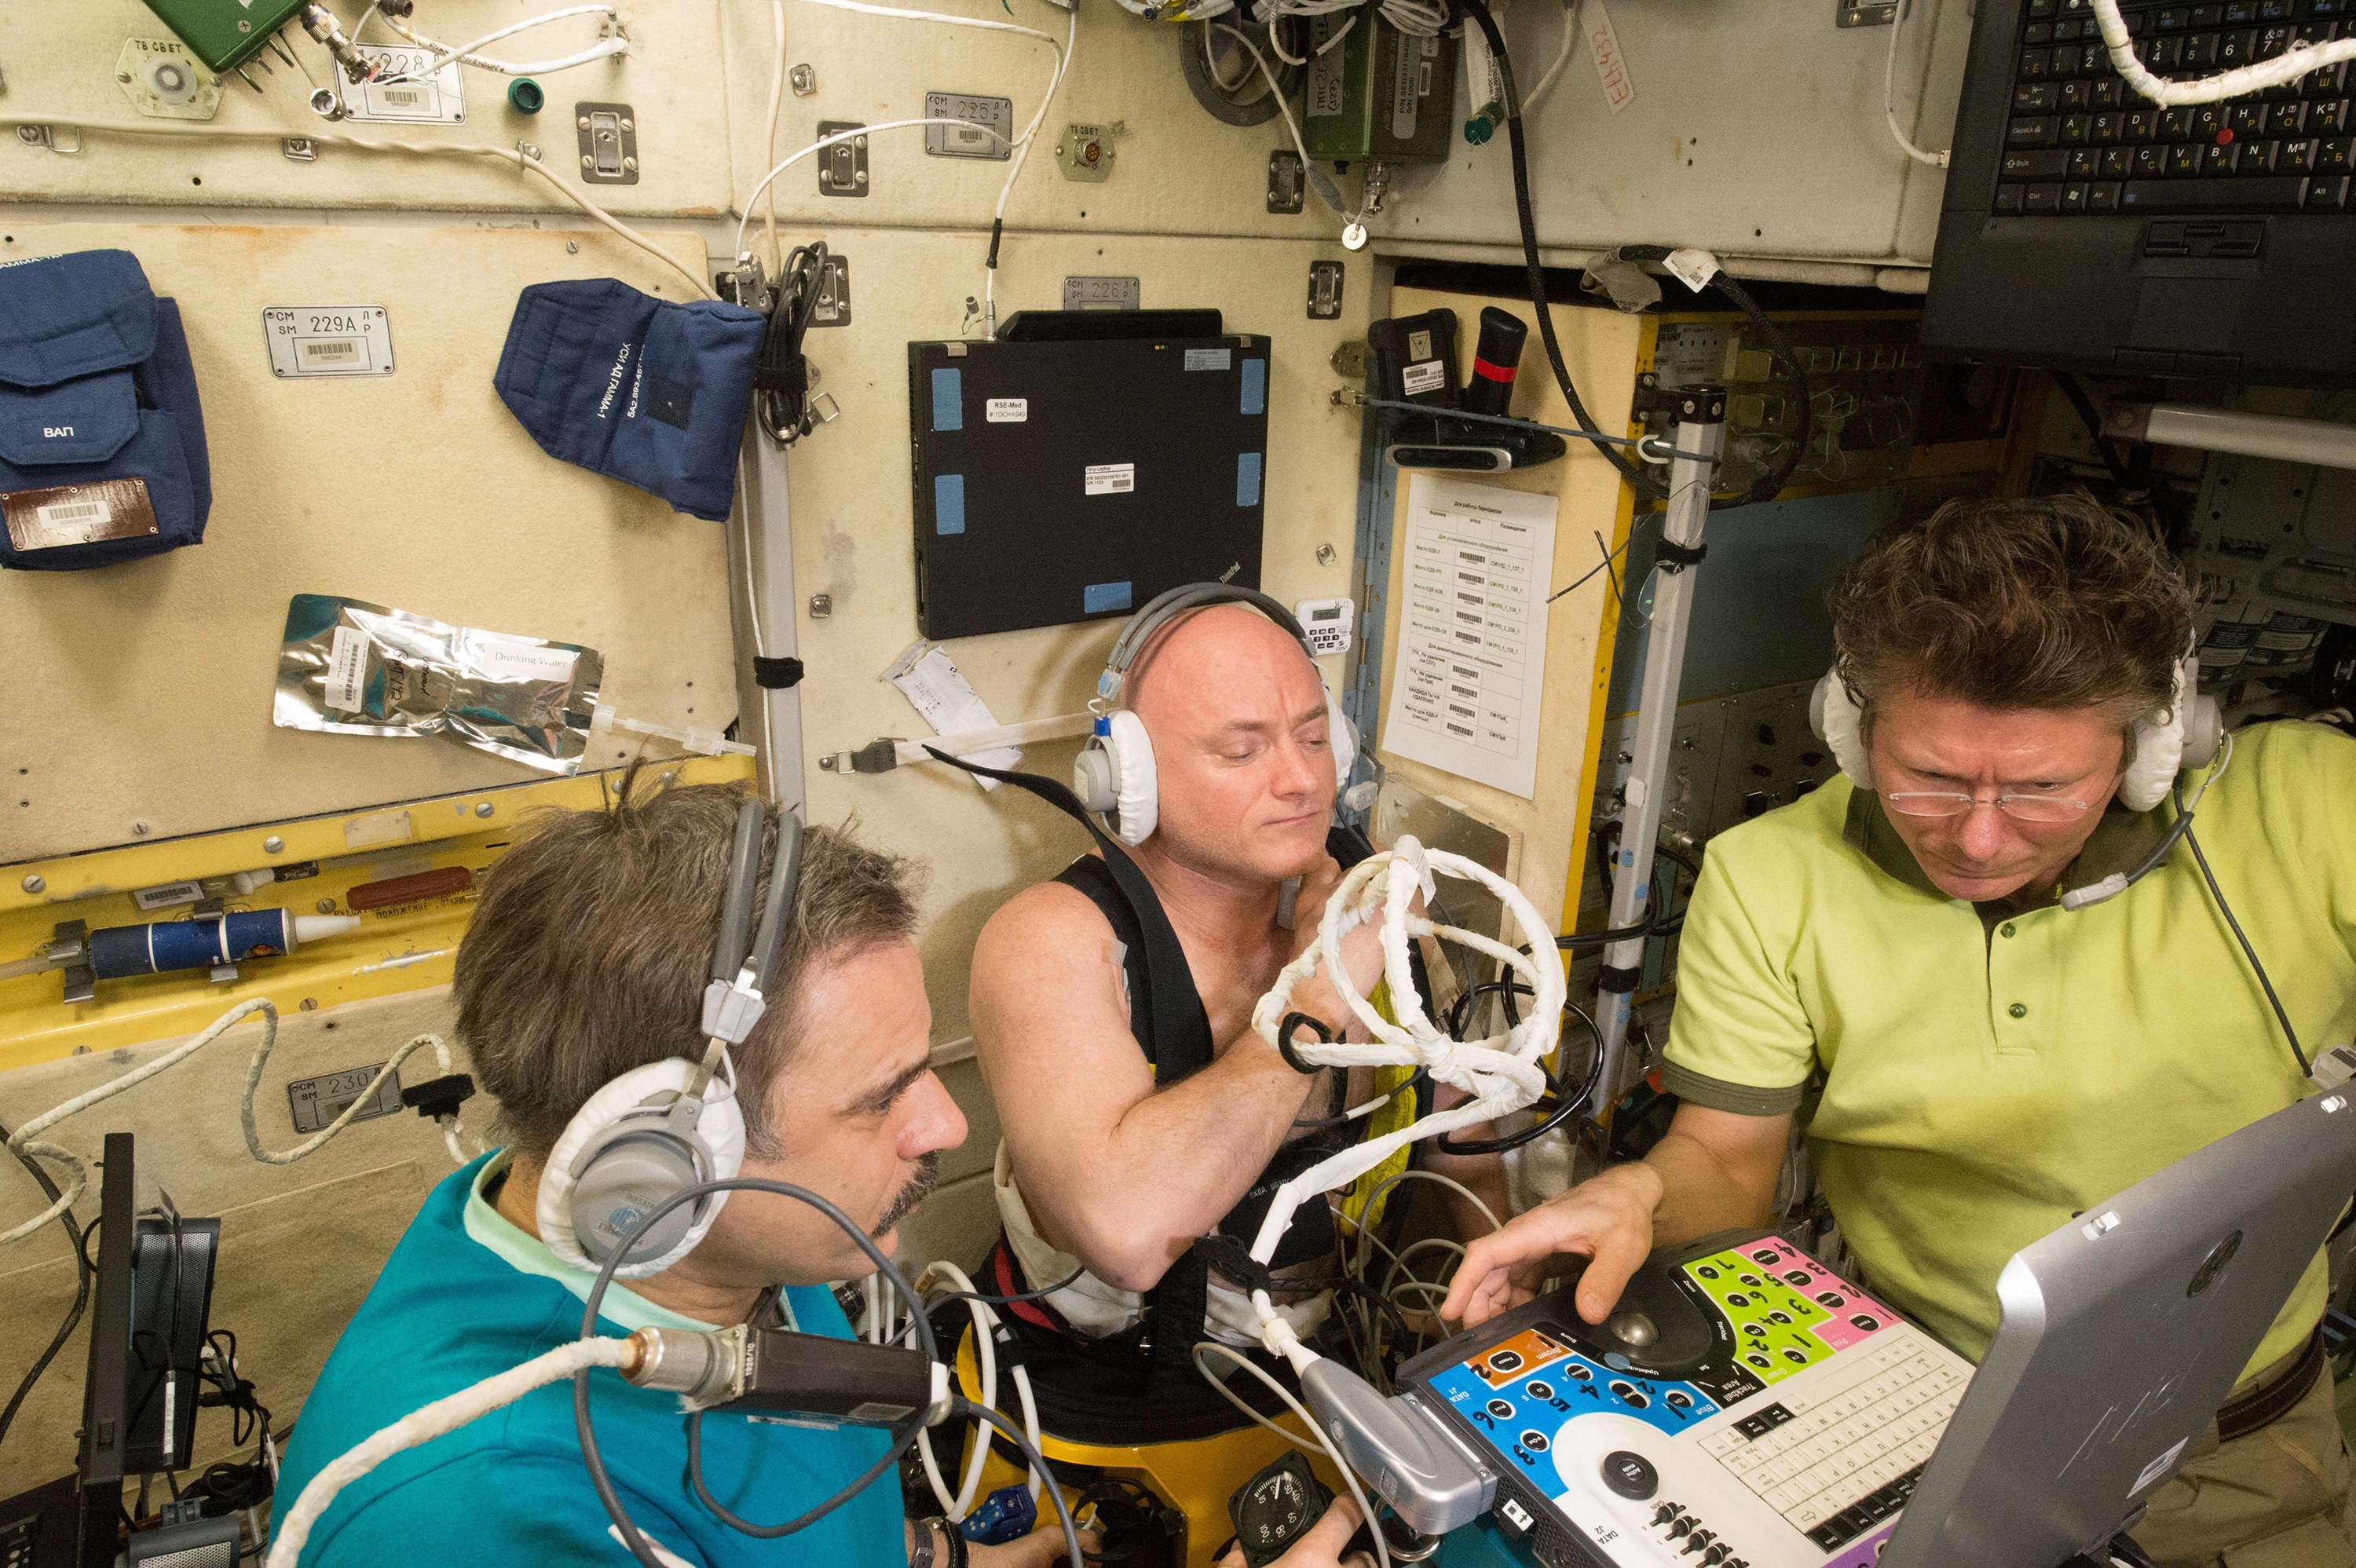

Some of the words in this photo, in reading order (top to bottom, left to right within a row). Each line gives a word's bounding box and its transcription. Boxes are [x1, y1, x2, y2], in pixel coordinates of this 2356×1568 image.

[135, 40, 149, 52] ТВ
[152, 42, 181, 53] СВЕТ
[2065, 84, 2075, 94] Q
[2098, 82, 2109, 92] W
[935, 108, 948, 118] SM
[957, 101, 989, 119] 225
[2239, 108, 2248, 118] H
[2066, 119, 2075, 128] A
[2098, 118, 2106, 127] S
[2131, 115, 2141, 125] D
[1092, 283, 1120, 298] 226
[276, 311, 294, 321] СМ
[278, 325, 297, 335] SM
[616, 342, 631, 364] УСИ
[610, 362, 624, 378] АД
[596, 378, 620, 418] ГАММА-1
[43, 426, 74, 438] ВАП
[1218, 561, 1241, 584] ThinkPad
[495, 652, 536, 665] Drinking
[539, 656, 567, 668] Water
[329, 1073, 368, 1094] 230
[301, 1091, 317, 1101] SM
[1773, 1241, 1798, 1259] 4
[1805, 1261, 1828, 1277] 3
[1748, 1289, 1769, 1304] 6
[1788, 1298, 1813, 1316] 3
[1758, 1316, 1777, 1326] 4
[1560, 1332, 1578, 1344] Store
[1833, 1337, 1849, 1348] Pink
[1535, 1346, 1564, 1361] Brown
[1697, 1364, 1710, 1372] Set
[1764, 1366, 1789, 1381] Green
[1721, 1378, 1740, 1391] Area
[1448, 1387, 1458, 1395] J1
[1448, 1391, 1470, 1403] DATA
[1578, 1383, 1601, 1400] 4
[1722, 1381, 1758, 1404] Trackball
[1549, 1397, 1572, 1413] 5
[1609, 1396, 1619, 1405] 2
[1494, 1404, 1508, 1413] Print
[1694, 1403, 1715, 1416] Blue
[1472, 1410, 1495, 1431] 6
[1527, 1435, 1543, 1446] V-Out
[1283, 1482, 1293, 1495] 30
[1291, 1489, 1301, 1500] 40
[1257, 1494, 1267, 1504] 10
[1650, 1500, 1666, 1511] GAIN
[1287, 1511, 1297, 1523] 60
[1259, 1523, 1271, 1538] 100
[1275, 1524, 1286, 1538] 80
[1593, 1525, 1604, 1535] J2
[1596, 1530, 1619, 1545] DATA
